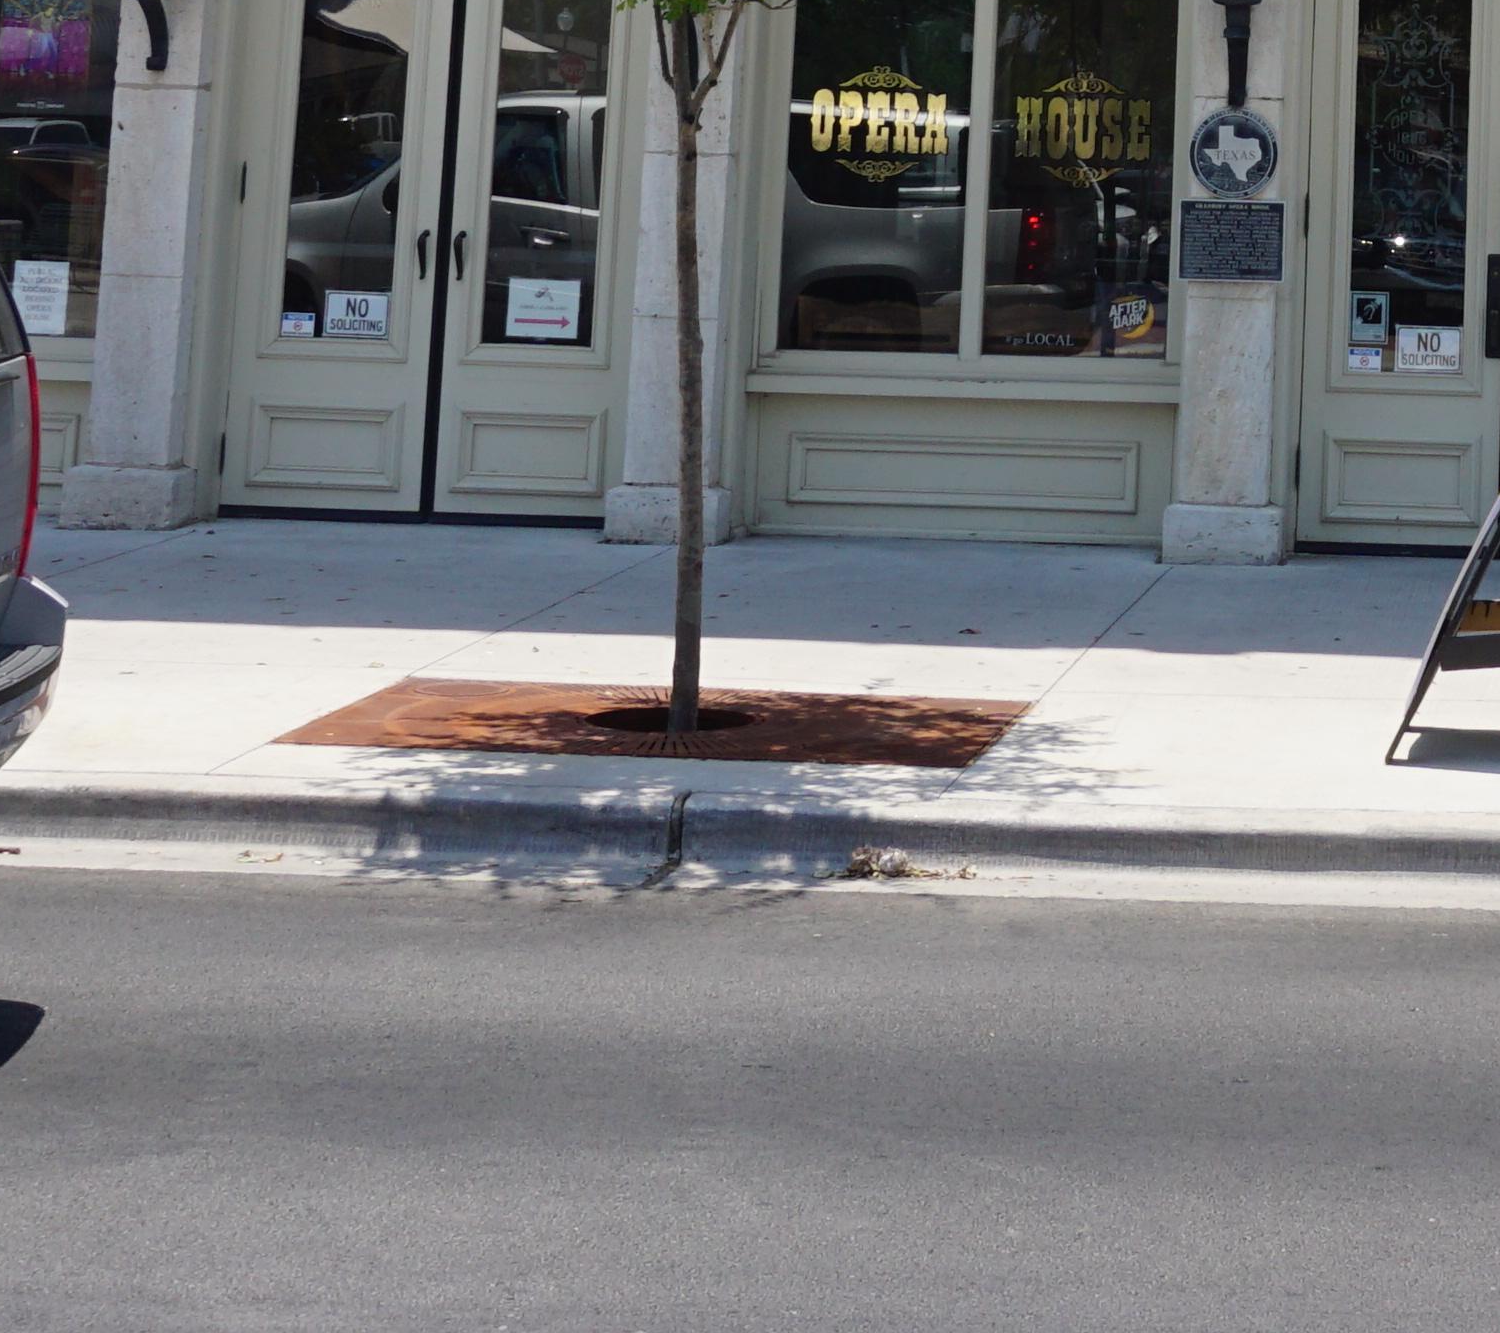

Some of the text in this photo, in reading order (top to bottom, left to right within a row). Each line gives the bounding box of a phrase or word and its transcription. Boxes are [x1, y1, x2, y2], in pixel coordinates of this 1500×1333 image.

[810, 88, 949, 155] OPERA
[1014, 96, 1151, 160] HOUSE
[1215, 149, 1257, 161] TEXAS
[345, 297, 370, 318] NO
[1108, 299, 1147, 318] AFTER
[329, 318, 384, 332] SOLICITING
[1113, 312, 1145, 330] DARK
[1416, 332, 1442, 353] NO
[1401, 351, 1457, 367] SOLICITING
